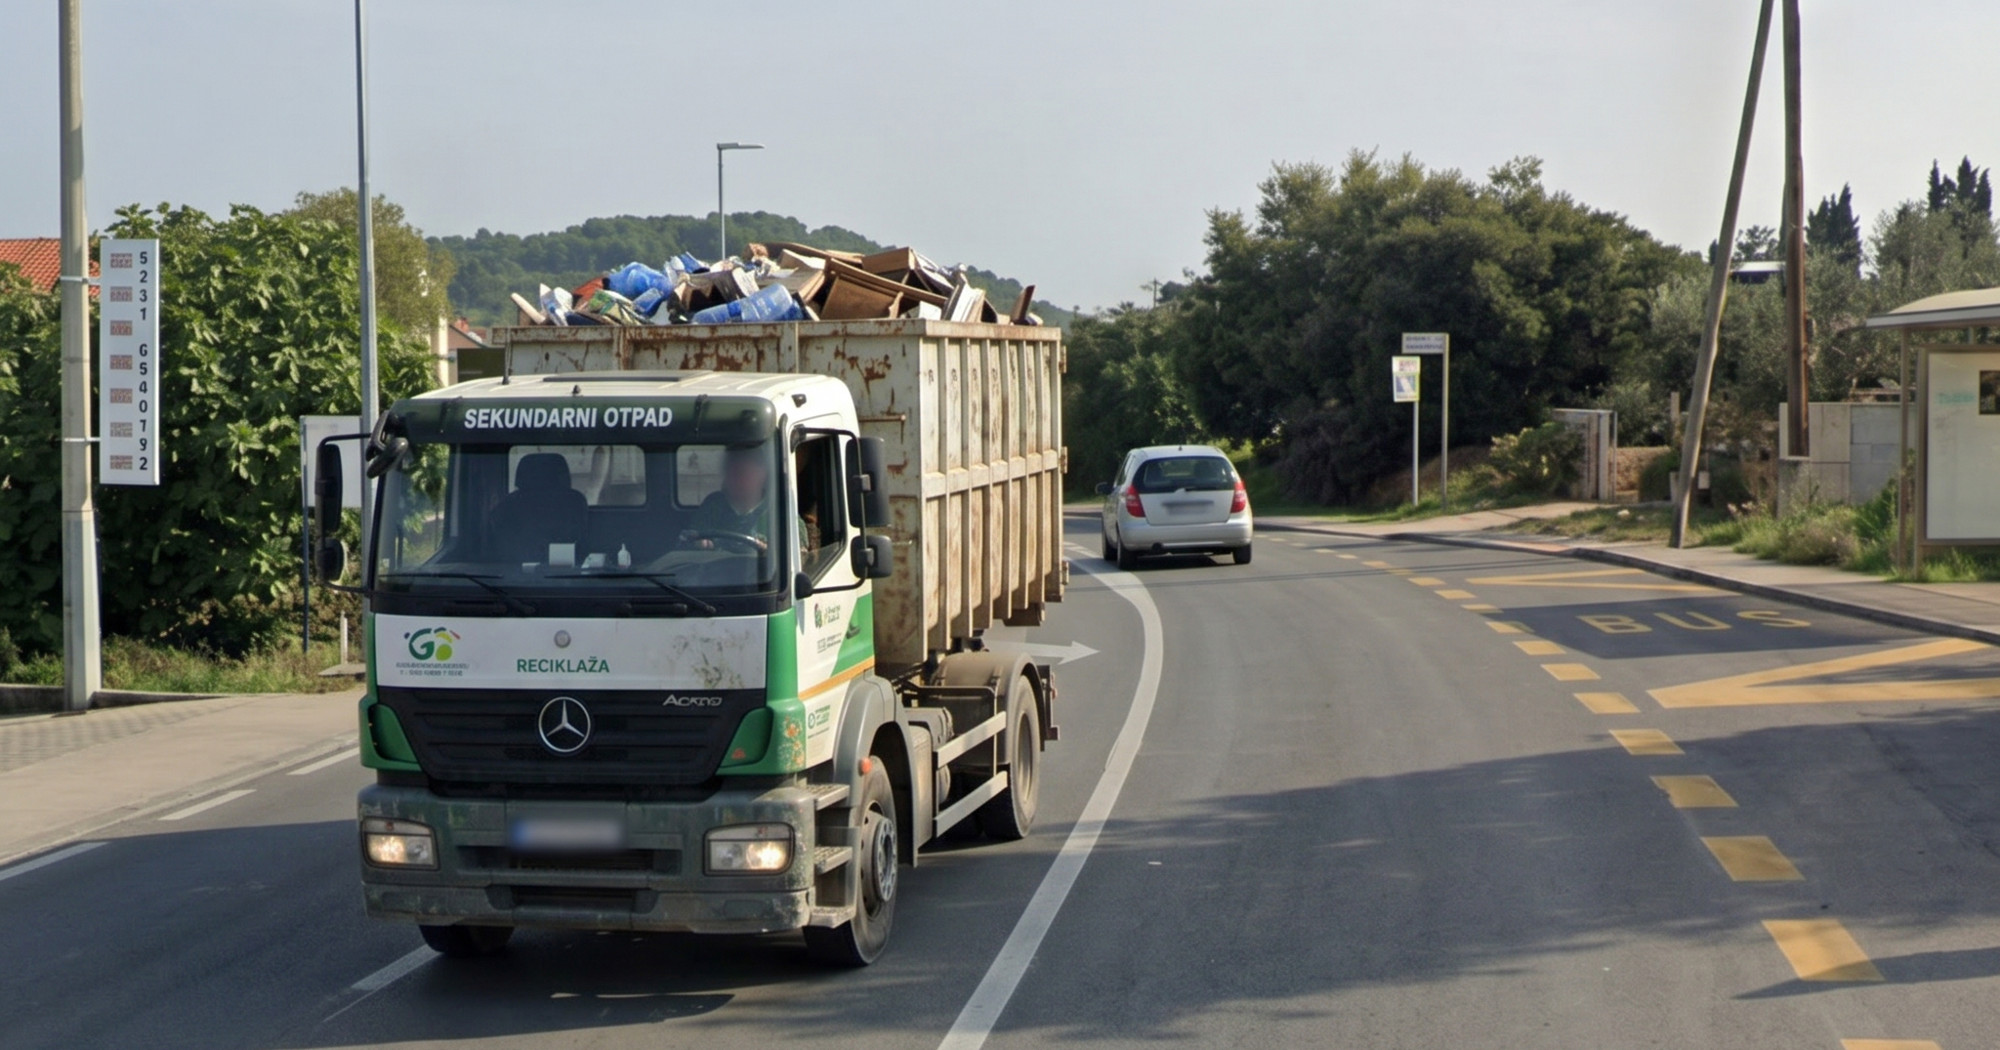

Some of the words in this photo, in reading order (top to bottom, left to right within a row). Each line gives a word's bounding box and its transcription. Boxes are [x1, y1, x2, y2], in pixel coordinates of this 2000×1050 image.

[464, 408, 598, 429] SEKUNDARNI
[603, 407, 673, 428] OTPAD
[1576, 610, 1812, 634] BUS
[516, 656, 610, 673] RECIKLAŽA
